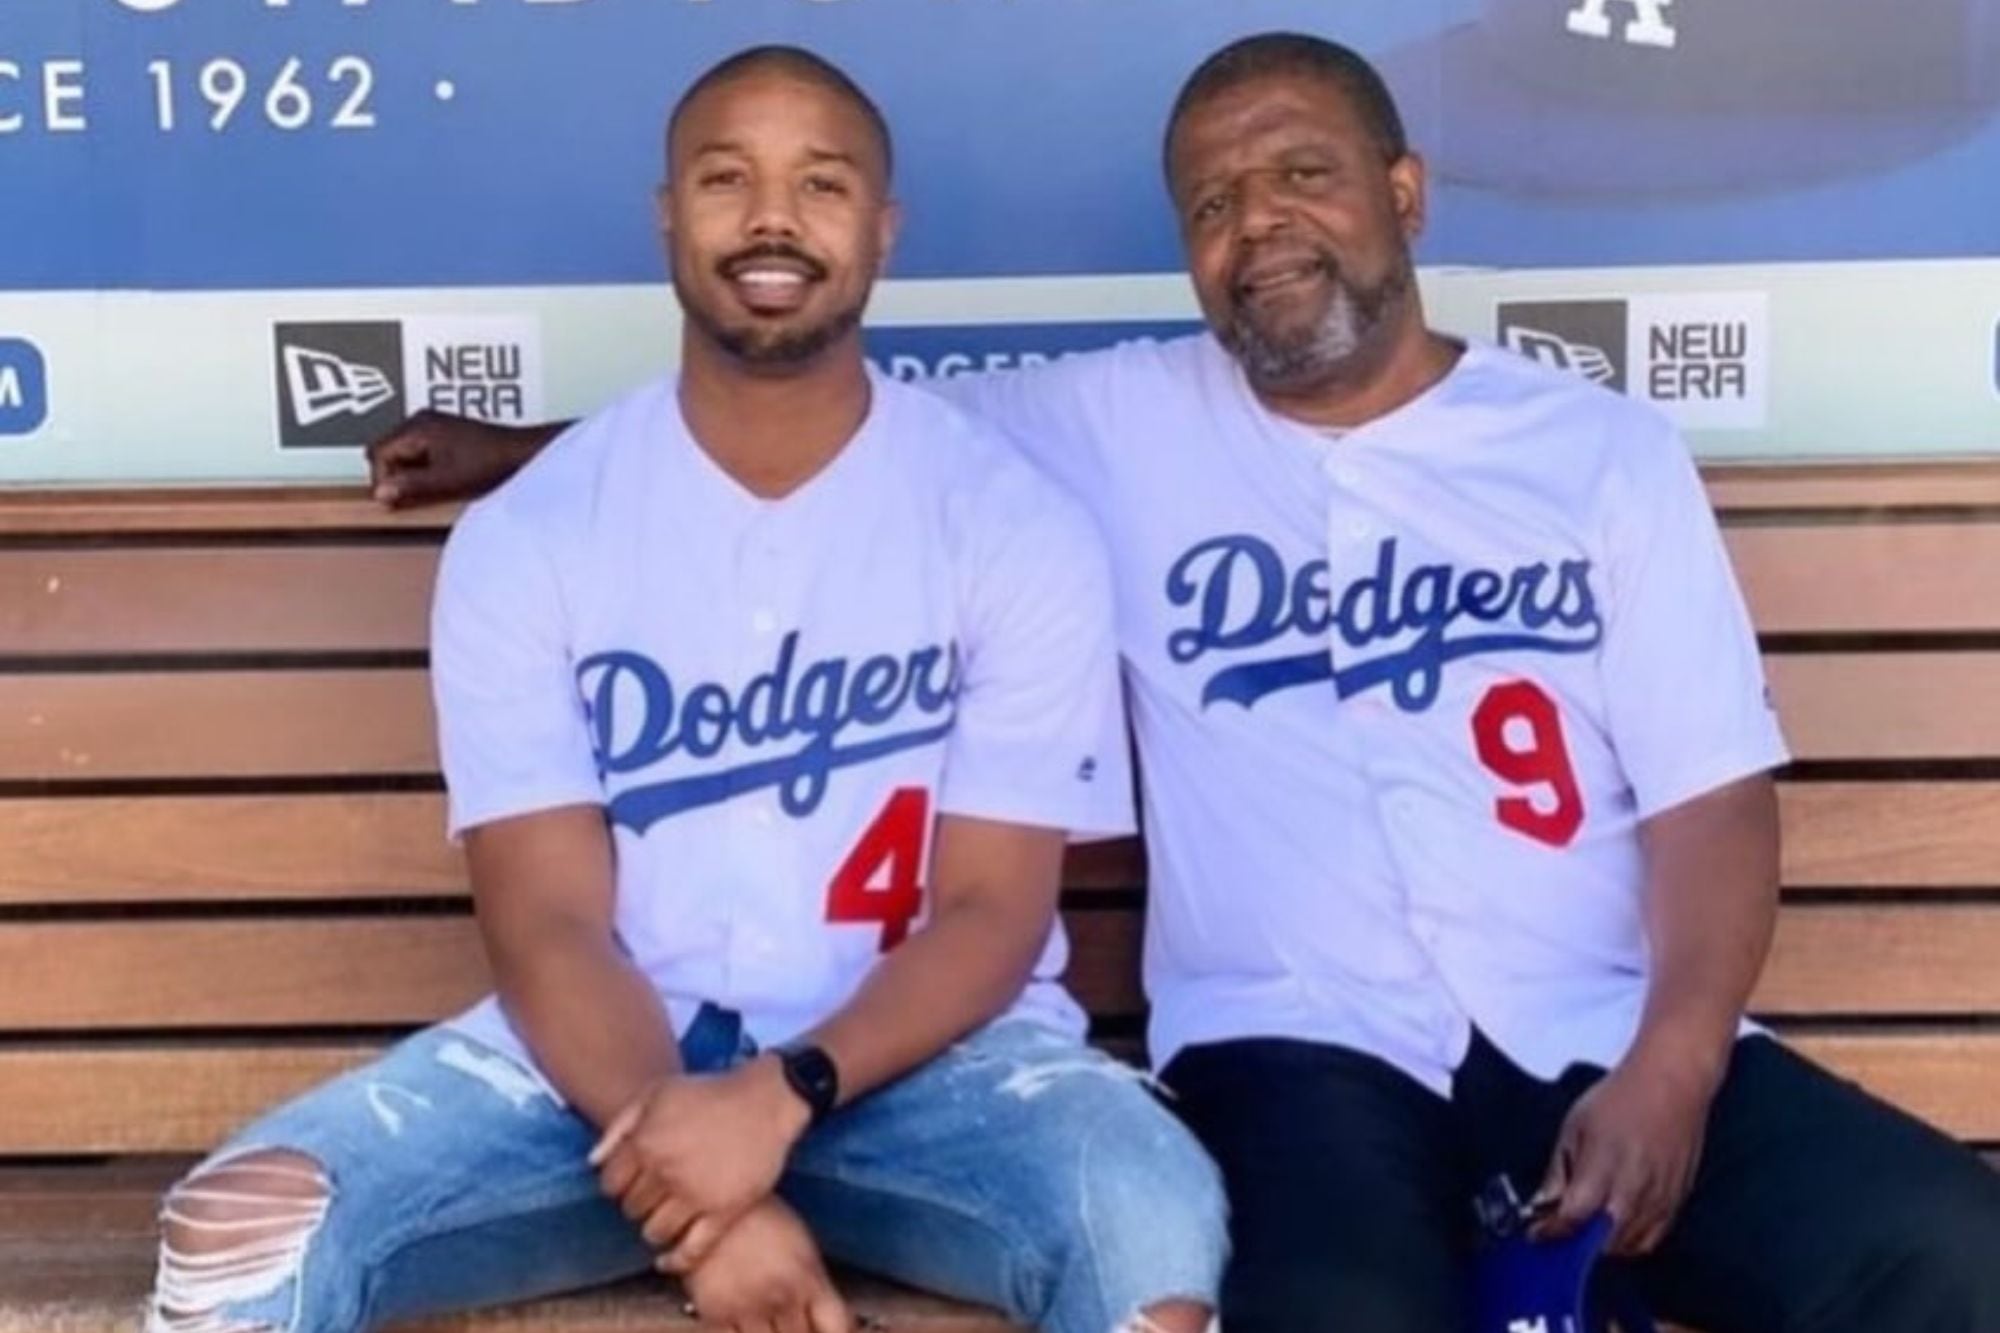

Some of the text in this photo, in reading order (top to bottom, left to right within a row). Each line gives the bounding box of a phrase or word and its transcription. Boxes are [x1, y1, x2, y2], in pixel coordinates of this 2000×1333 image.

[147, 55, 376, 131] 1962
[426, 344, 521, 381] NEW
[1650, 323, 1746, 361] NEW
[427, 383, 523, 419] ERA
[1650, 363, 1745, 400] ERA
[1166, 534, 1601, 713] Dodgers
[575, 630, 958, 825] Dodger
[1471, 678, 1585, 848] 9
[824, 786, 930, 954] 4
